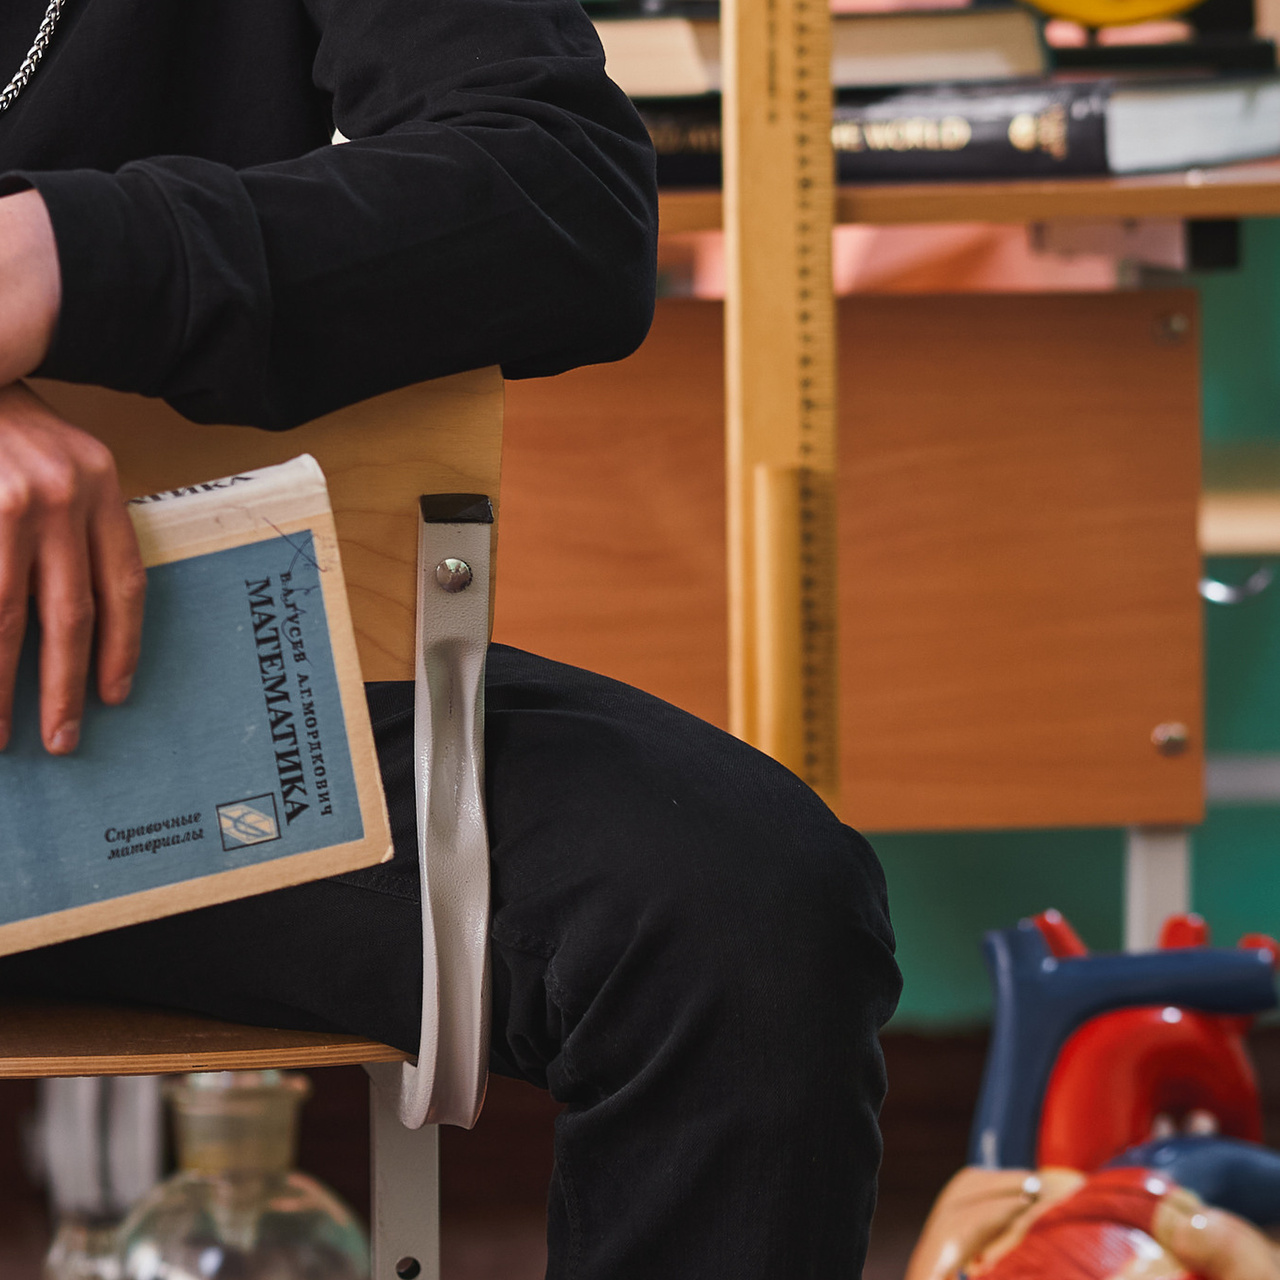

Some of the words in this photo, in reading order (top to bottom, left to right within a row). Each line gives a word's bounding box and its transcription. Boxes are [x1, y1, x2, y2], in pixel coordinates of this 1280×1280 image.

[244, 576, 310, 826] МАТЕМАТИКА
[104, 812, 202, 843] Справочные
[107, 829, 204, 860] материалы
